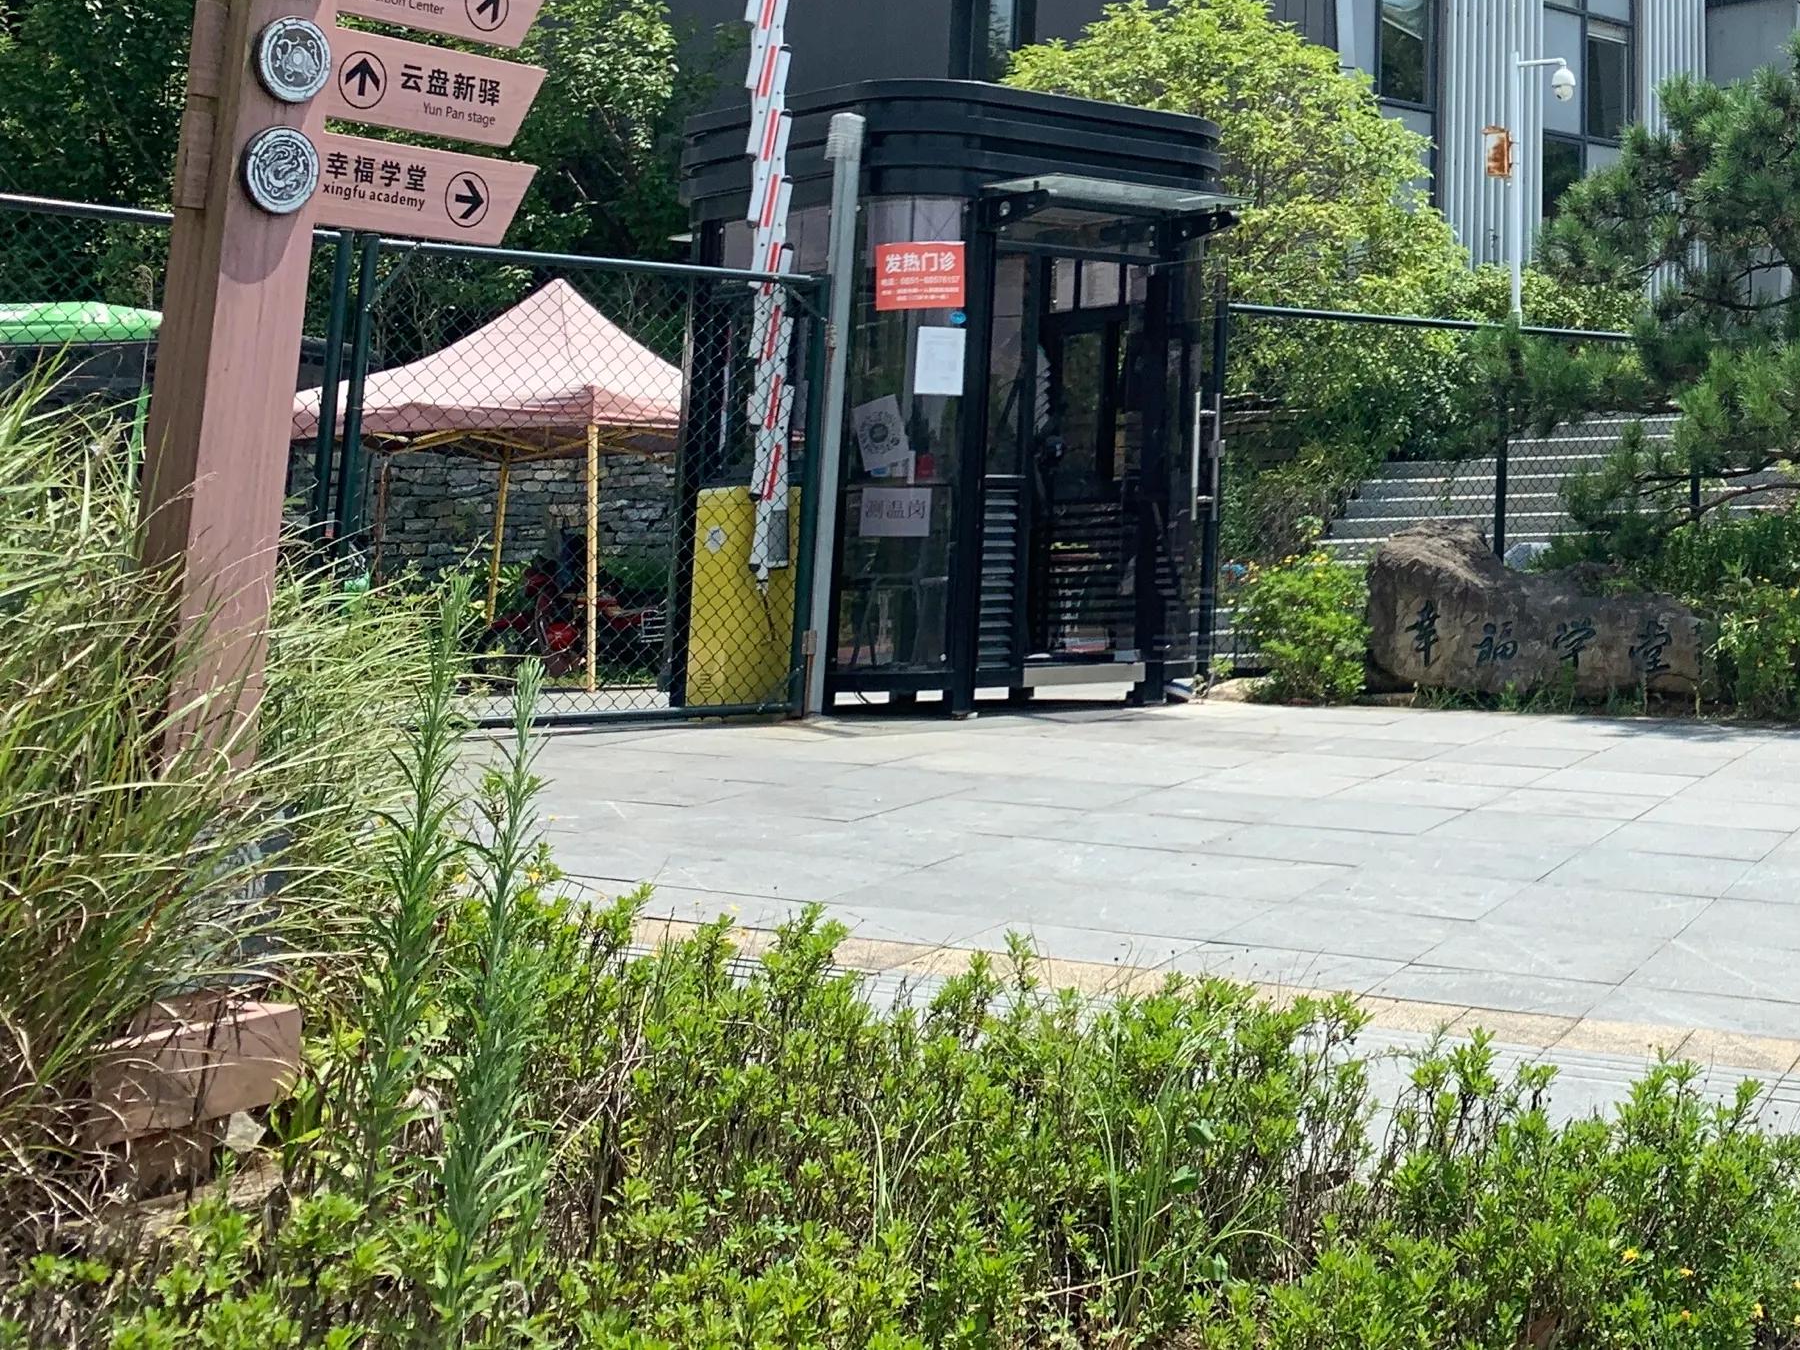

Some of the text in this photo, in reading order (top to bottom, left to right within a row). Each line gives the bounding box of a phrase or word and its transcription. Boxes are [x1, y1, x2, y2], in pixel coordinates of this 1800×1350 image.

[401, 64, 500, 106] 云盘新驿
[424, 102, 496, 127] Yun Pan stage
[326, 152, 426, 192] 幸福学堂
[323, 181, 426, 211] xingfu academy
[885, 252, 956, 274] 发热门诊
[865, 499, 926, 519] 测温岗
